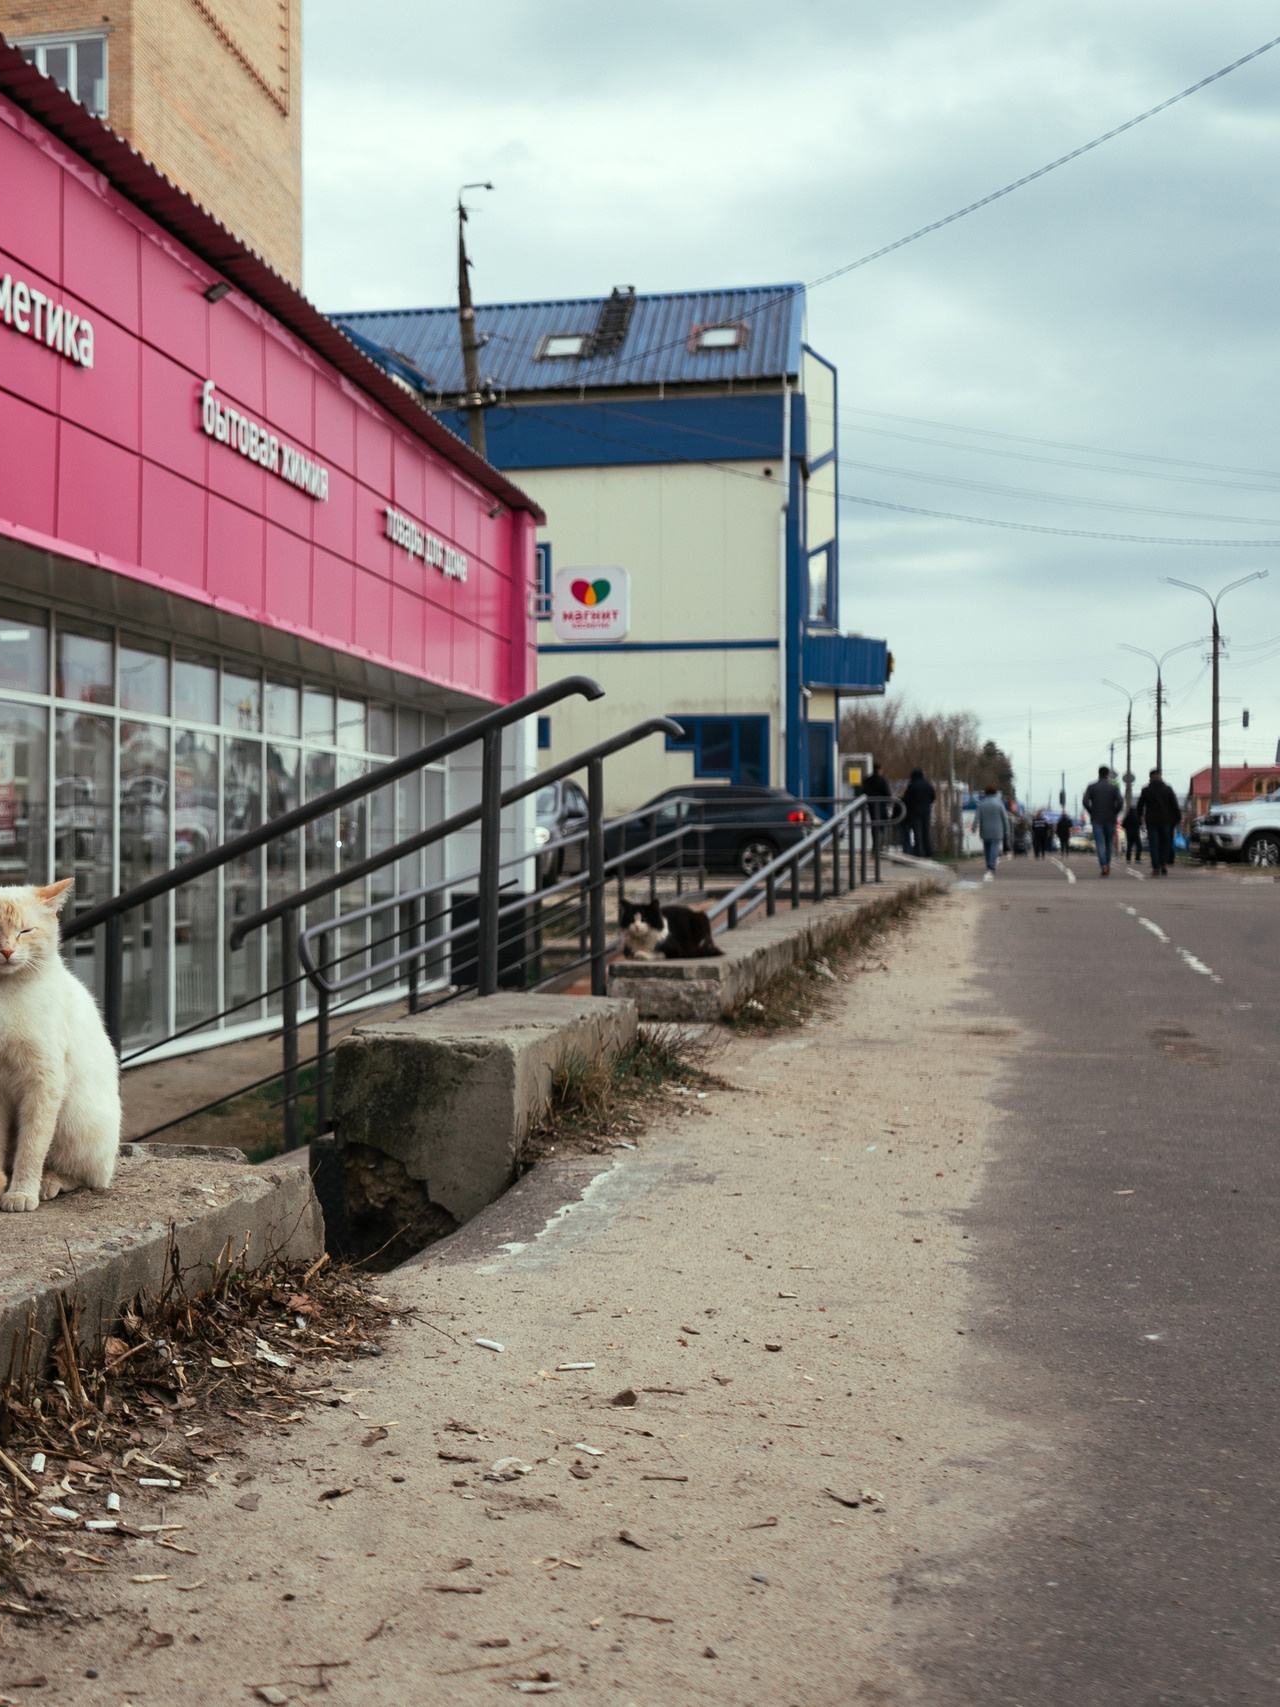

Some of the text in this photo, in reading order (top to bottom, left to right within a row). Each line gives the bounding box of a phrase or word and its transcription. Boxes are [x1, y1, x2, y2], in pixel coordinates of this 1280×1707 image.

[202, 379, 329, 503] бытовая химия
[385, 505, 425, 561] товары
[443, 544, 468, 583] дома
[562, 609, 620, 622] магнит
